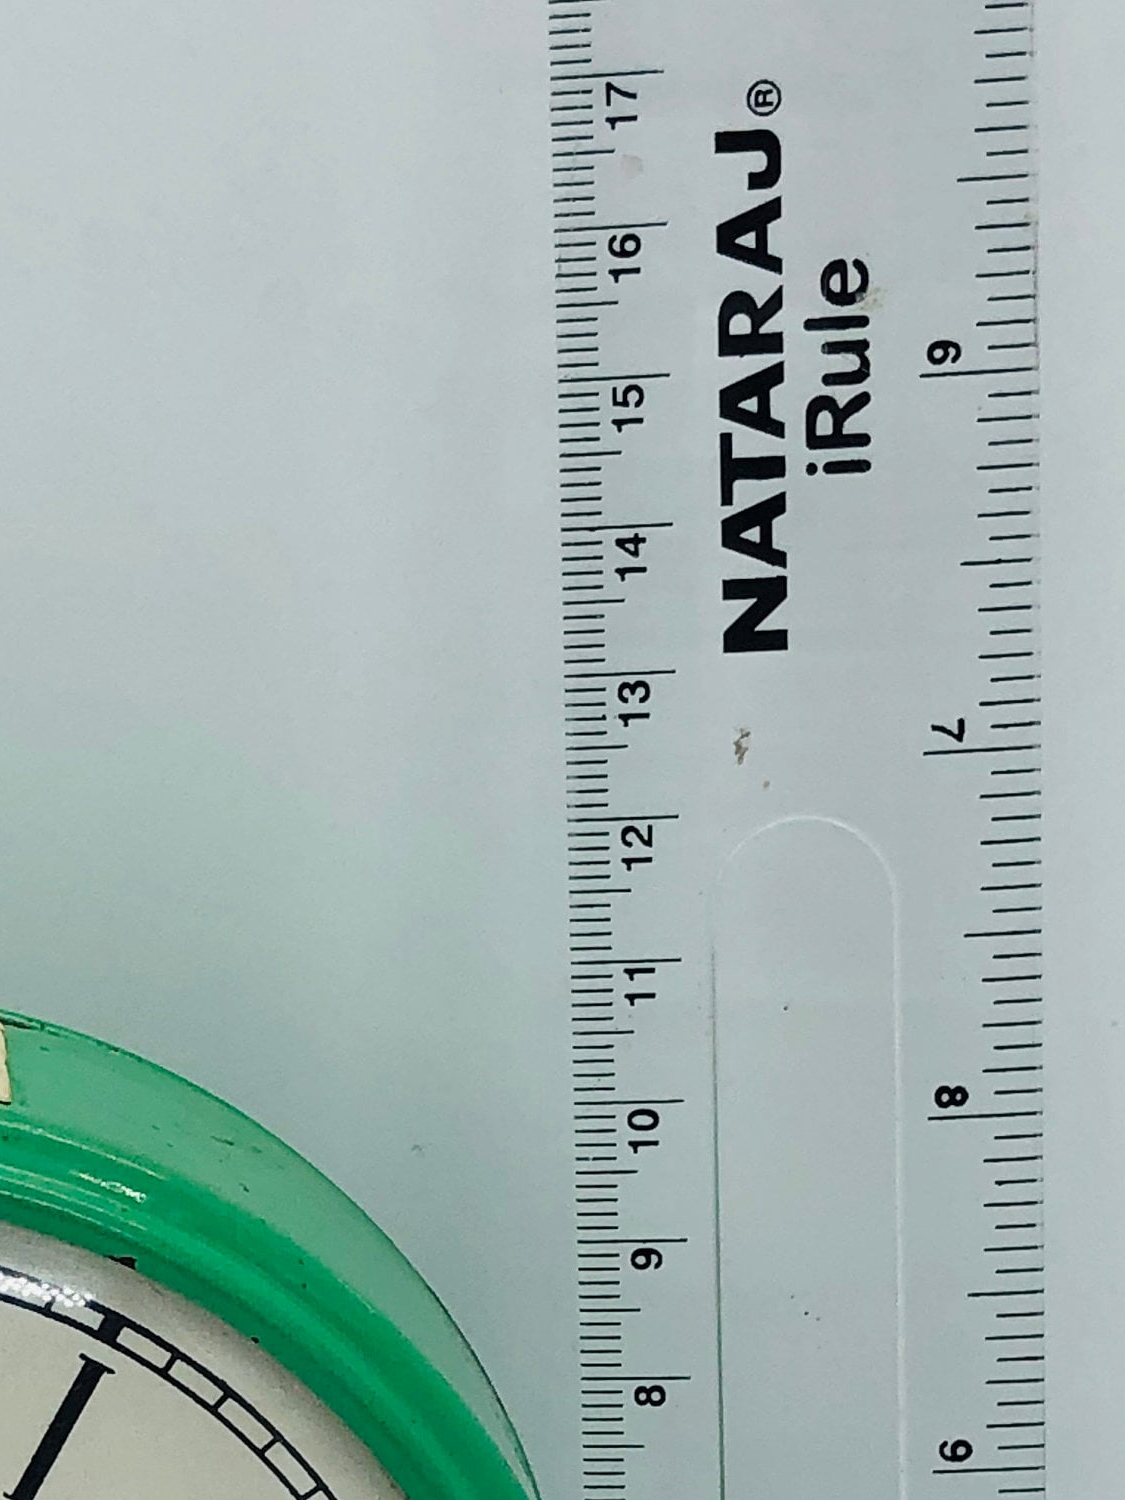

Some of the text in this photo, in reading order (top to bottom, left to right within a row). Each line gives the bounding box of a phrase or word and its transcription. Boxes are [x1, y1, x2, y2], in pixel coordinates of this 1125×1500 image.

[605, 82, 637, 130] 17
[608, 232, 642, 284] 16
[804, 258, 871, 476] iRule
[611, 384, 644, 433] 15
[615, 533, 647, 582] 14
[617, 680, 651, 728] 13
[931, 718, 965, 742] 7
[621, 825, 652, 871] 12
[623, 968, 656, 1006] 11
[935, 1086, 969, 1108] 8
[627, 1109, 659, 1154] 10
[631, 1248, 662, 1270] 9
[634, 1385, 666, 1406] 8
